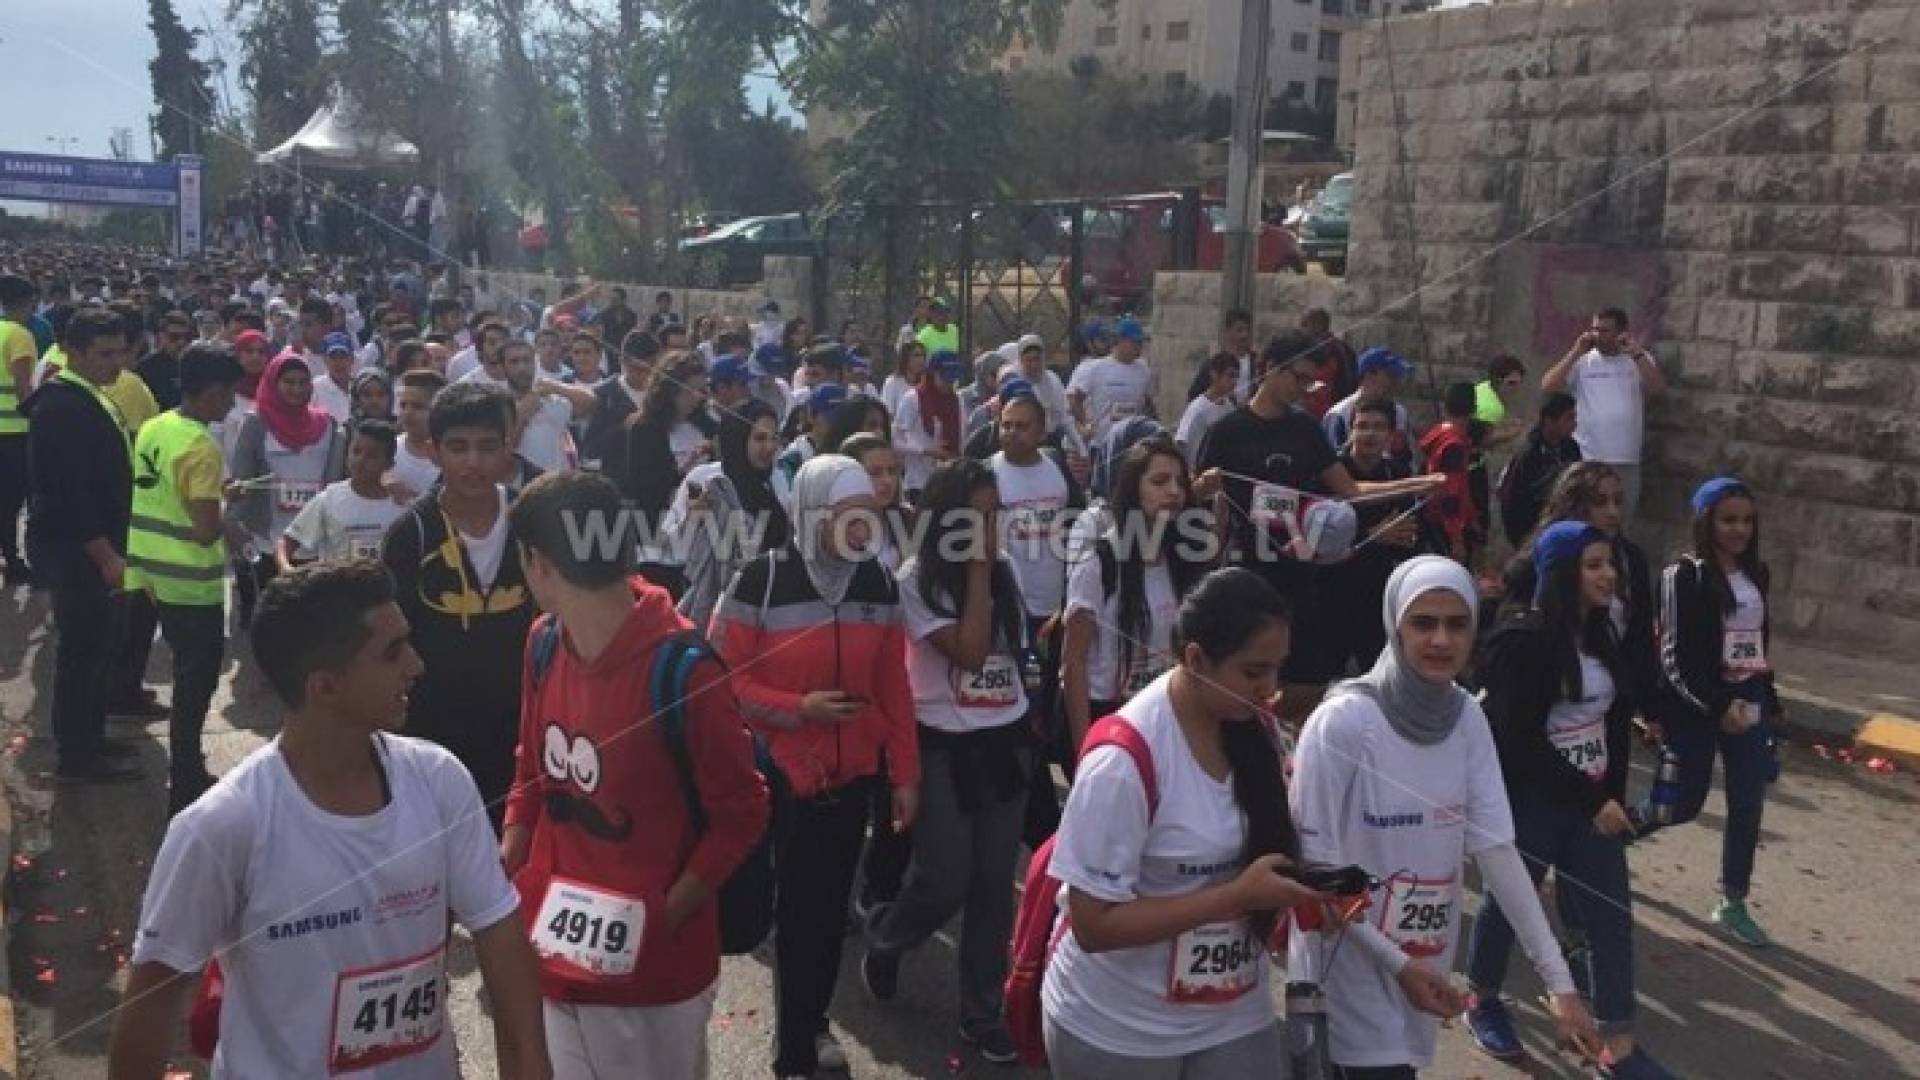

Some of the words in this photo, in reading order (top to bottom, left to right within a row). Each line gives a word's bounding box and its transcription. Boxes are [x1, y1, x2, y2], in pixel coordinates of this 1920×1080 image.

[266, 906, 363, 940] SAMSUNG
[547, 906, 629, 954] 4919
[1398, 897, 1451, 931] 295
[352, 977, 437, 1034] 4145
